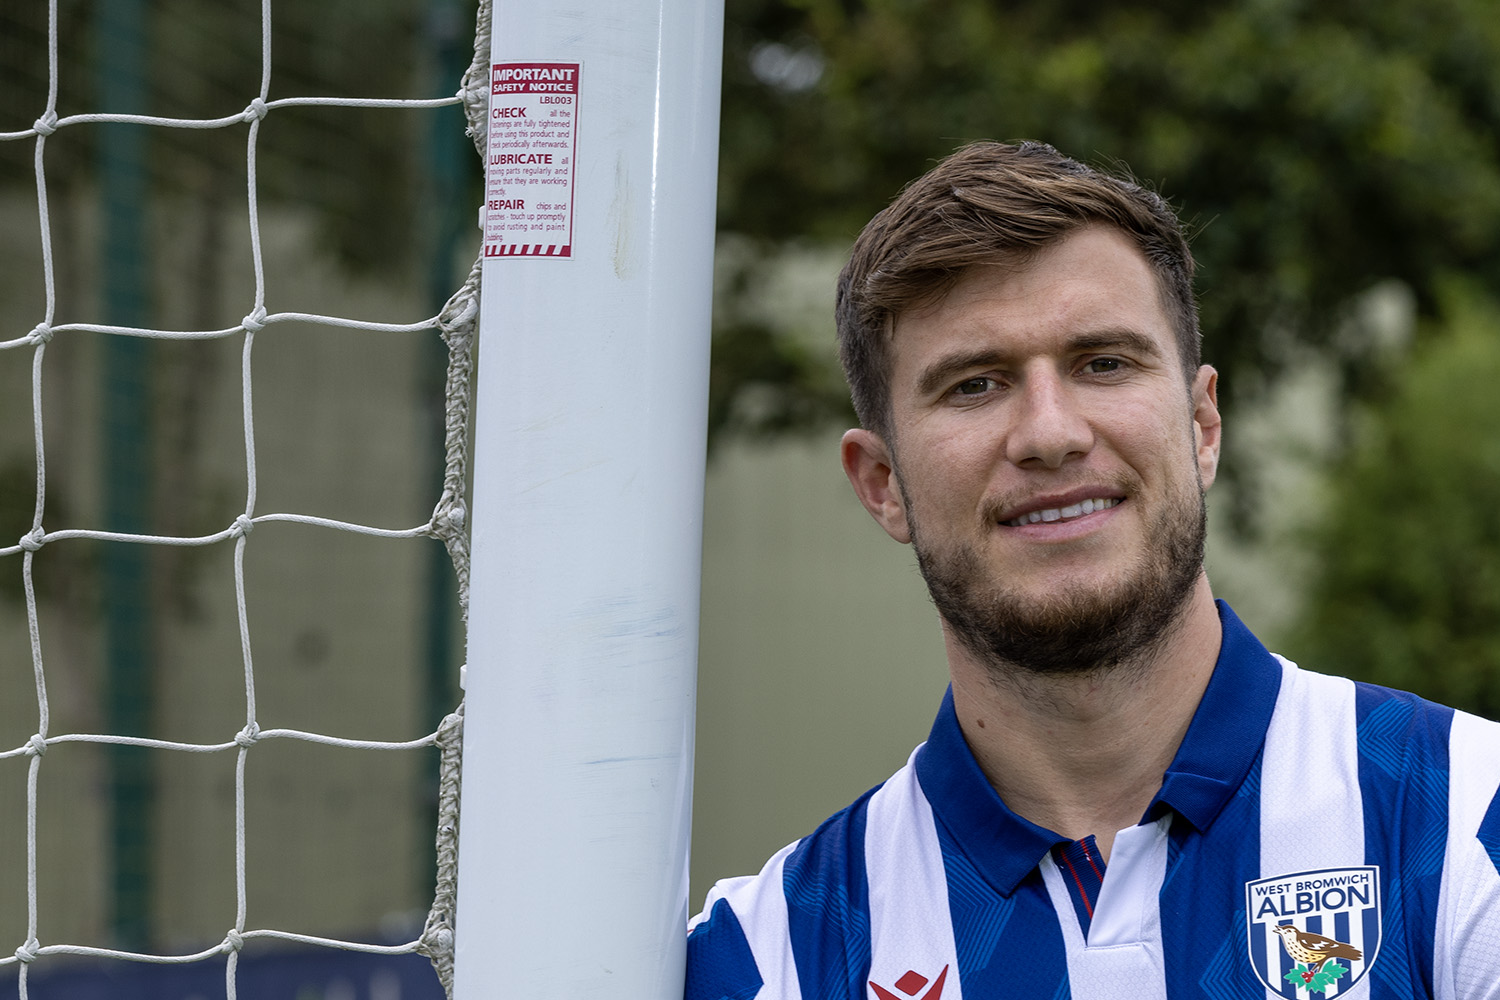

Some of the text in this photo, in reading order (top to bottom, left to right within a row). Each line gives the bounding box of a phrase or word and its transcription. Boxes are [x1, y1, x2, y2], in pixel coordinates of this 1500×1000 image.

[494, 69, 574, 81] IMPORTANT
[494, 84, 526, 92] SAFETY
[492, 107, 526, 118] CHECK
[524, 120, 536, 129] fully
[539, 120, 570, 129] tightened
[505, 131, 516, 139] using
[530, 130, 554, 138] product
[502, 140, 530, 149] periodically
[532, 140, 569, 148] afterwards.
[490, 154, 552, 165] LUBRICATE
[523, 167, 552, 176] regularly
[514, 178, 526, 186] they
[541, 178, 567, 187] working
[488, 200, 524, 210] REPAIR
[536, 202, 552, 211] chips
[537, 213, 566, 222] promptly
[507, 223, 527, 232] rusting
[546, 223, 565, 232] paint
[1255, 873, 1369, 896] WEST BROMWICH
[1256, 884, 1370, 919] ALBION
